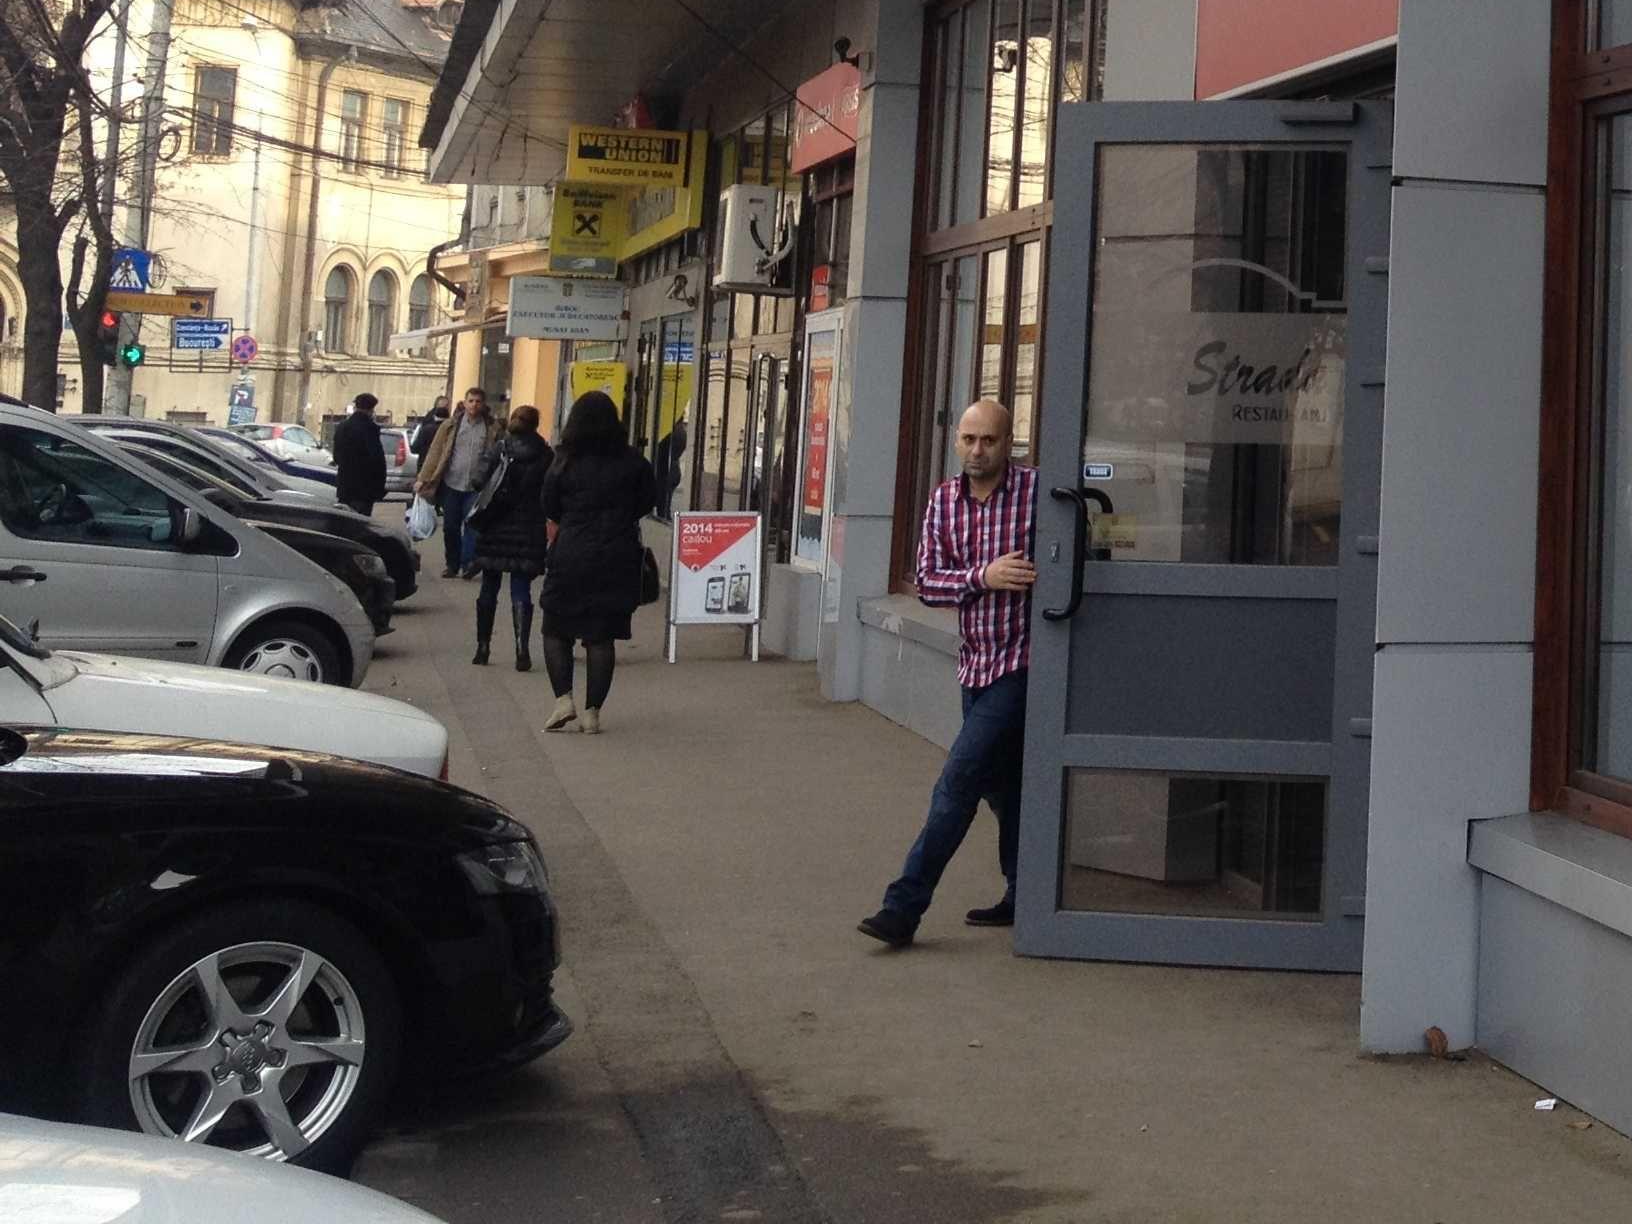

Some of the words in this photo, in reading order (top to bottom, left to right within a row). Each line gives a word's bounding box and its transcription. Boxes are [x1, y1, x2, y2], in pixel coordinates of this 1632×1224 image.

[580, 134, 663, 150] WESTERN
[604, 147, 662, 162] UNION
[587, 166, 634, 176] TRANSFER
[682, 522, 713, 534] 2014
